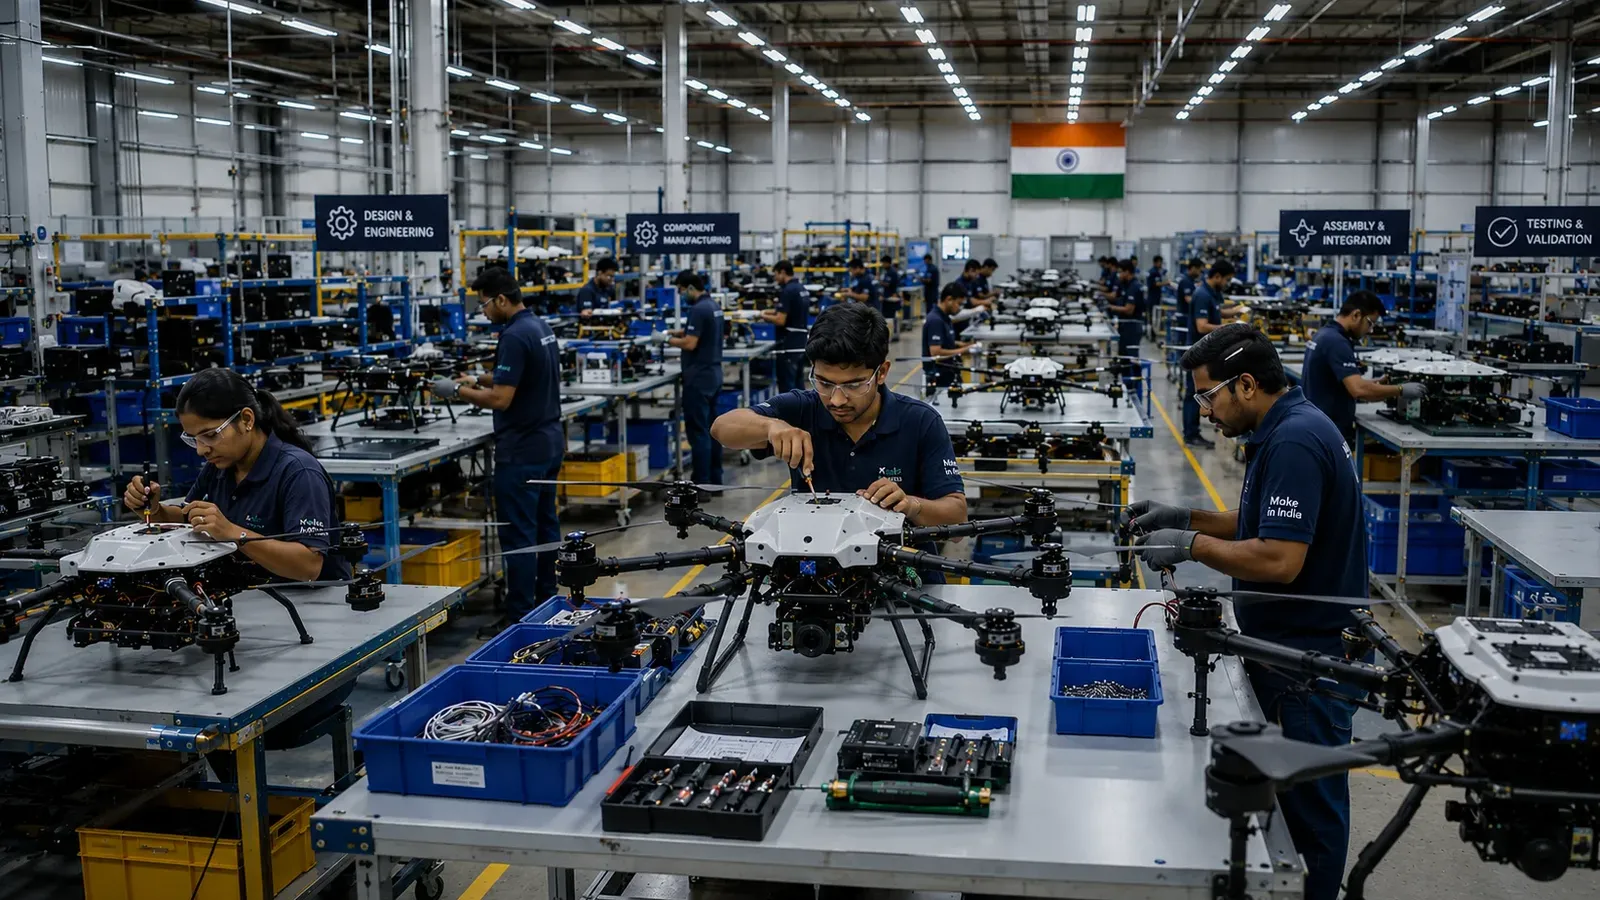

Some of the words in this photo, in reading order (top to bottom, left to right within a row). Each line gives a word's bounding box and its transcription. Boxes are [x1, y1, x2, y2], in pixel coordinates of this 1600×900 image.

[364, 210, 403, 222] DESIGN
[405, 210, 414, 222] &
[662, 223, 716, 233] COMPONENT
[1322, 220, 1375, 231] ASSEMBLY
[1376, 220, 1385, 231] &
[1526, 218, 1573, 229] TESTING
[1575, 218, 1584, 229] &
[364, 226, 435, 238] ENGINEERING
[662, 235, 732, 246] MANUFACTURING
[1322, 234, 1392, 246] INTEGRATION
[1526, 233, 1593, 245] VALIDATION
[1266, 506, 1276, 517] in
